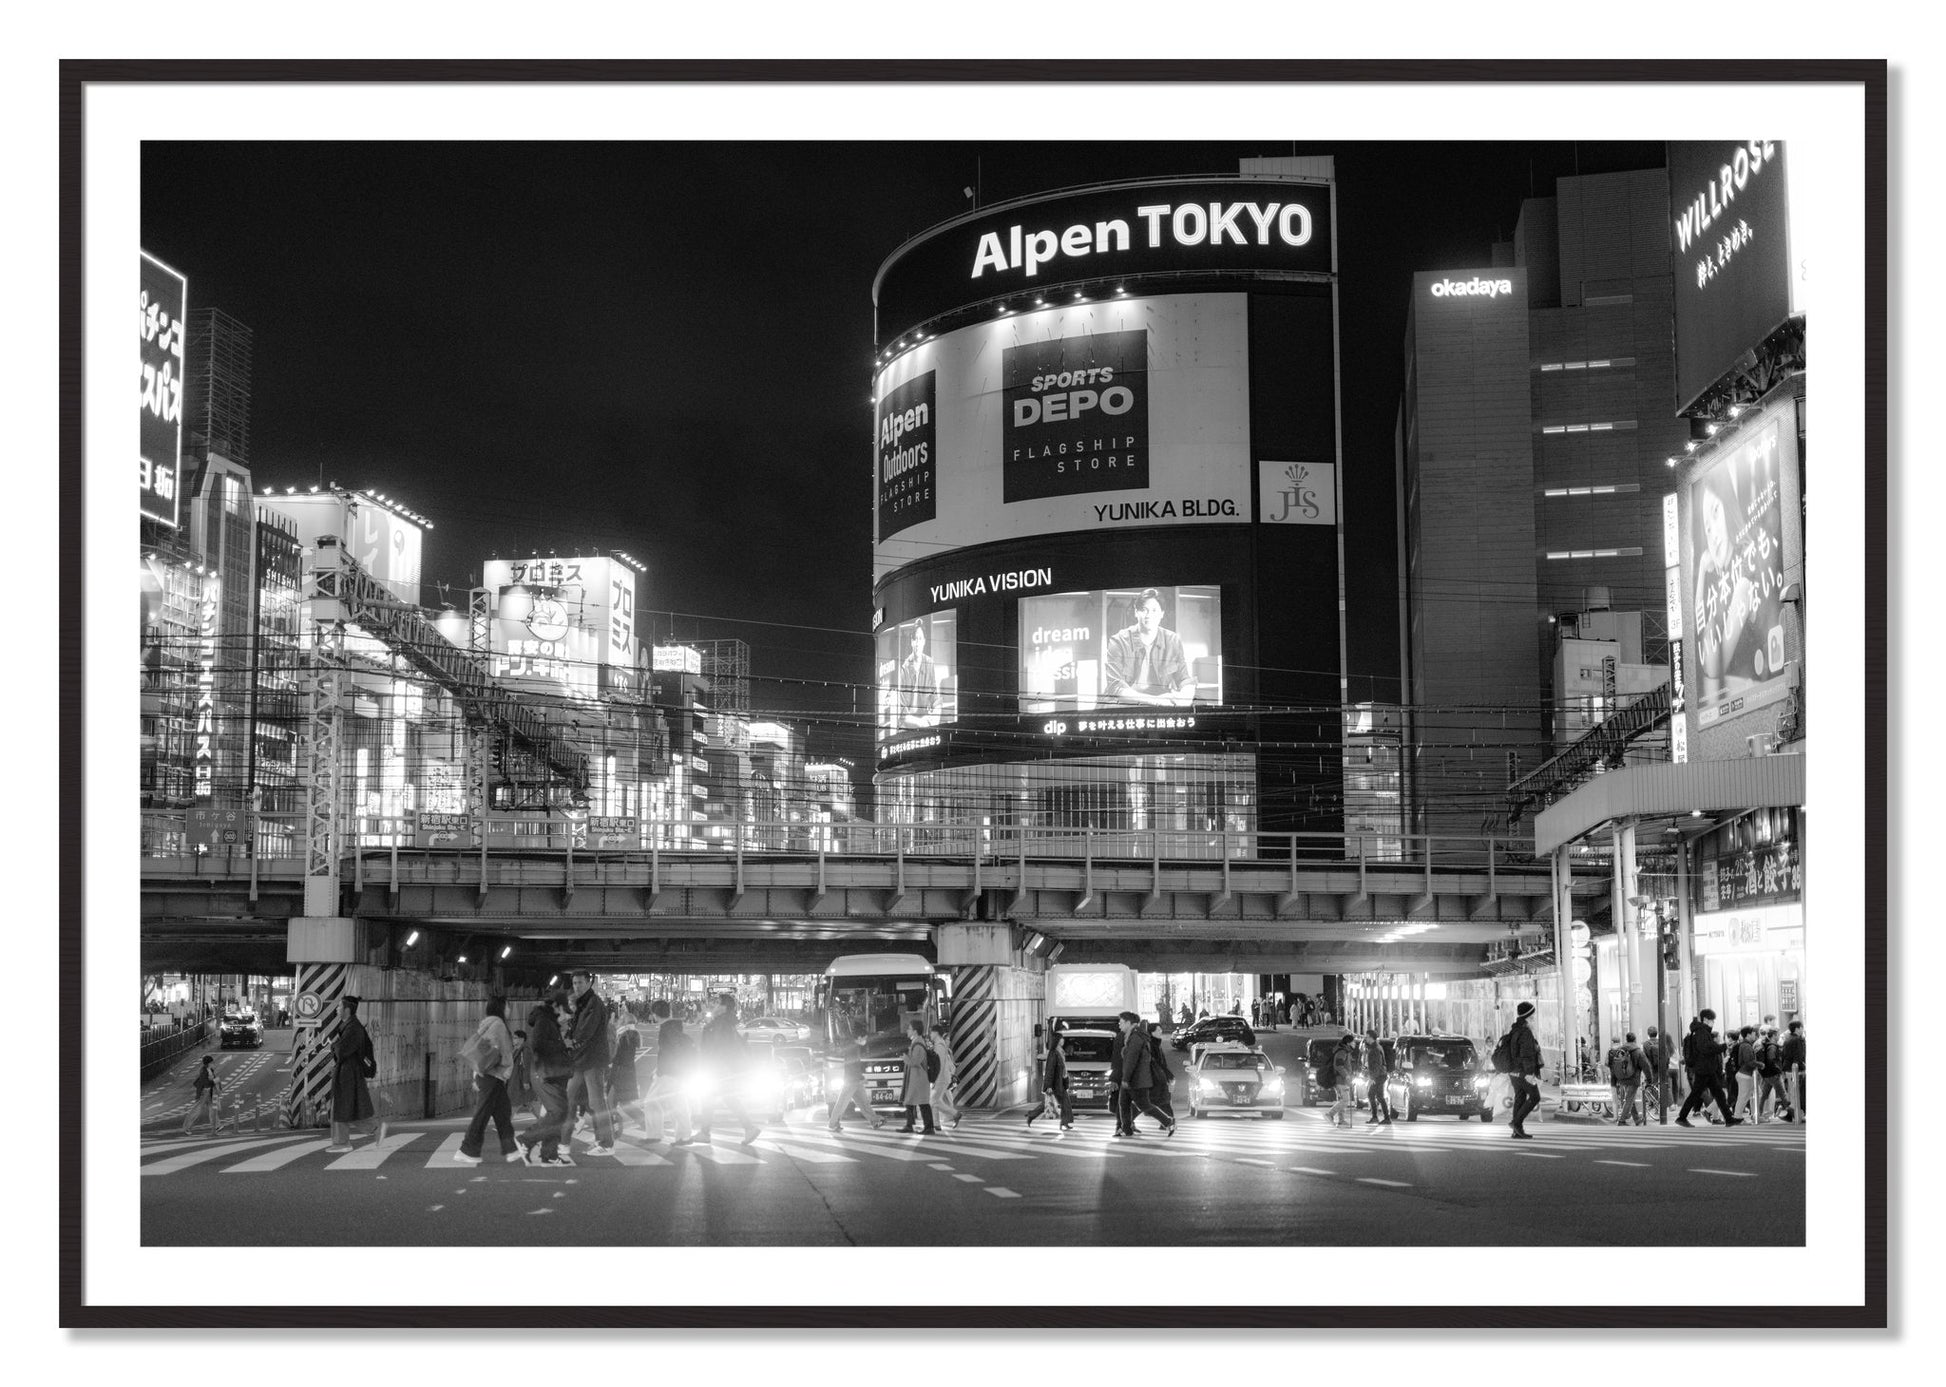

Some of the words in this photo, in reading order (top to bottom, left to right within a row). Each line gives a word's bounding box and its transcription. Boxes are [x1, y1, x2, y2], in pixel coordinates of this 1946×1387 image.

[971, 219, 1130, 279] Alpen
[1138, 202, 1312, 248] TOKYO
[1431, 277, 1512, 298] okadaya
[1031, 366, 1113, 392] SPORTS
[1014, 386, 1134, 428] DEPO
[881, 402, 929, 450] Alpen
[1013, 436, 1134, 461] FLAGSHIP
[883, 442, 928, 484] Outdoors
[1057, 455, 1134, 473] STORE
[880, 471, 929, 505] FLAGSHIP
[894, 488, 929, 513] STORE
[1094, 501, 1177, 522] YUNIKA
[1182, 499, 1240, 517] BLDG.
[265, 567, 297, 590] SHISHA
[510, 562, 583, 582] プロミス
[930, 577, 986, 603] YUNIKA
[989, 568, 1052, 591] VISION
[1032, 626, 1090, 645] dream
[195, 584, 217, 796] パチンコエスパス日拓
[1044, 720, 1067, 735] dip
[1078, 717, 1196, 732] 夢を叶える仕事に出会おう
[420, 814, 468, 825] 新宿駅東口
[590, 817, 635, 828] 新宿駅東口
